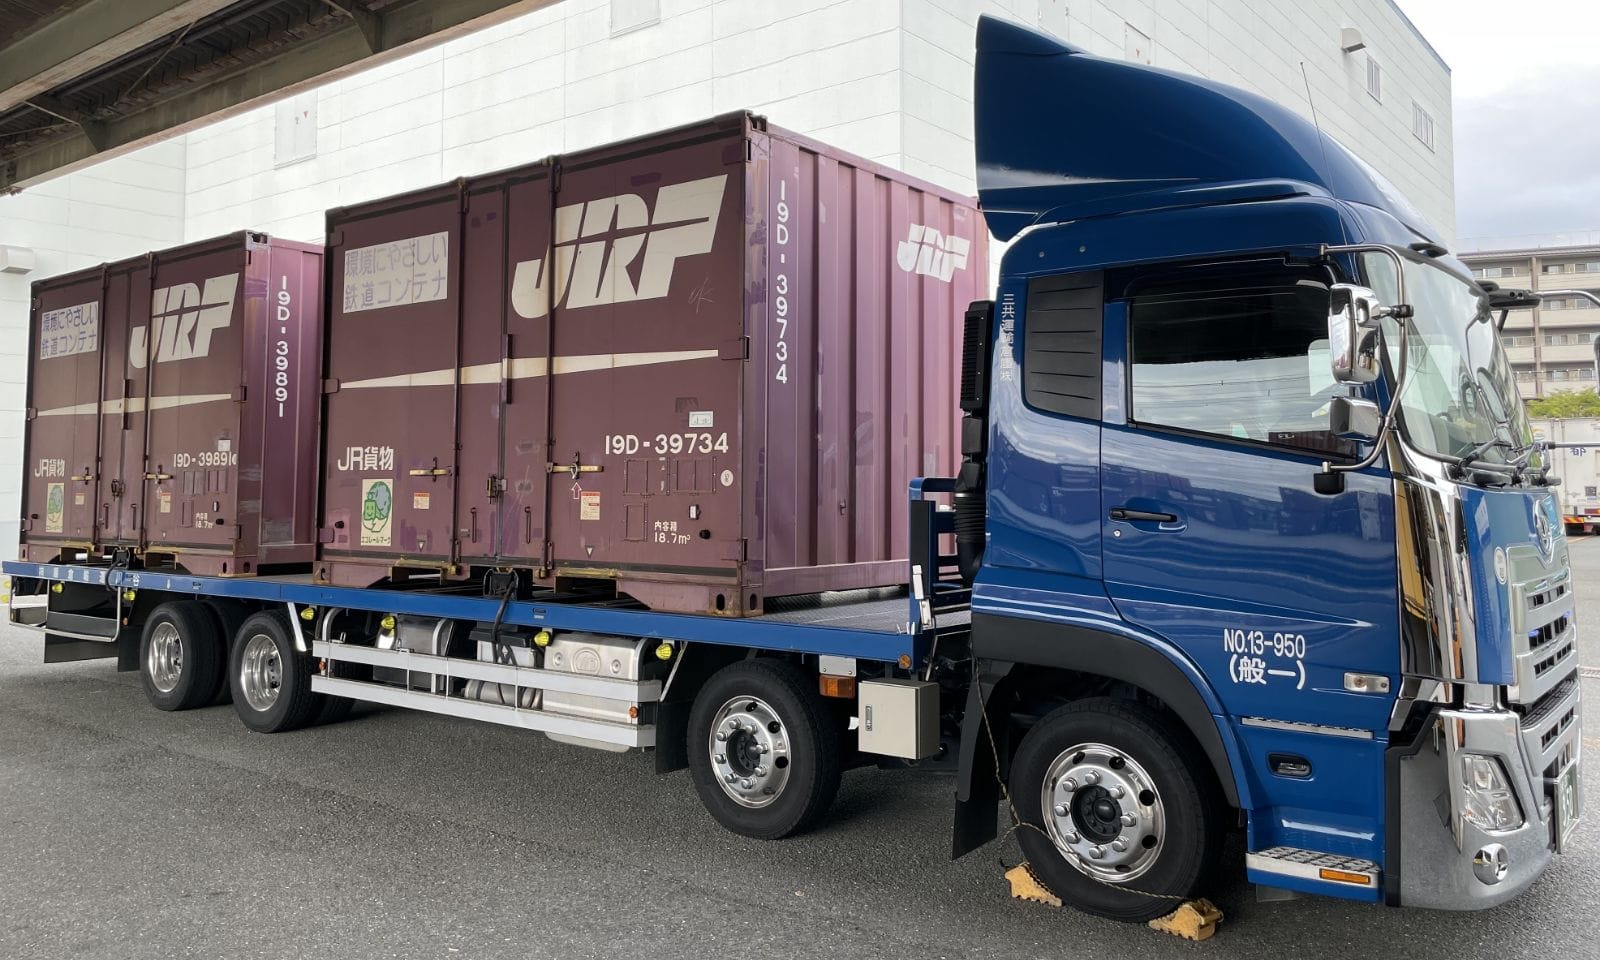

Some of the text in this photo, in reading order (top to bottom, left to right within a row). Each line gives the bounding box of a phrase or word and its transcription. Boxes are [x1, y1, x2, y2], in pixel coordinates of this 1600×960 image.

[345, 235, 447, 278] 環境にやさしい
[511, 174, 728, 319] JRF
[896, 223, 970, 282] JRF
[344, 269, 446, 310] 鉄道コンテナ
[776, 179, 789, 384] 19D-39734
[129, 272, 239, 369] JRF
[275, 275, 290, 417] 19D-39891
[337, 446, 394, 471] JR貨物
[605, 432, 729, 455] 19D-39734
[34, 459, 65, 478] JR貨物
[1223, 628, 1306, 659] NO.13-950
